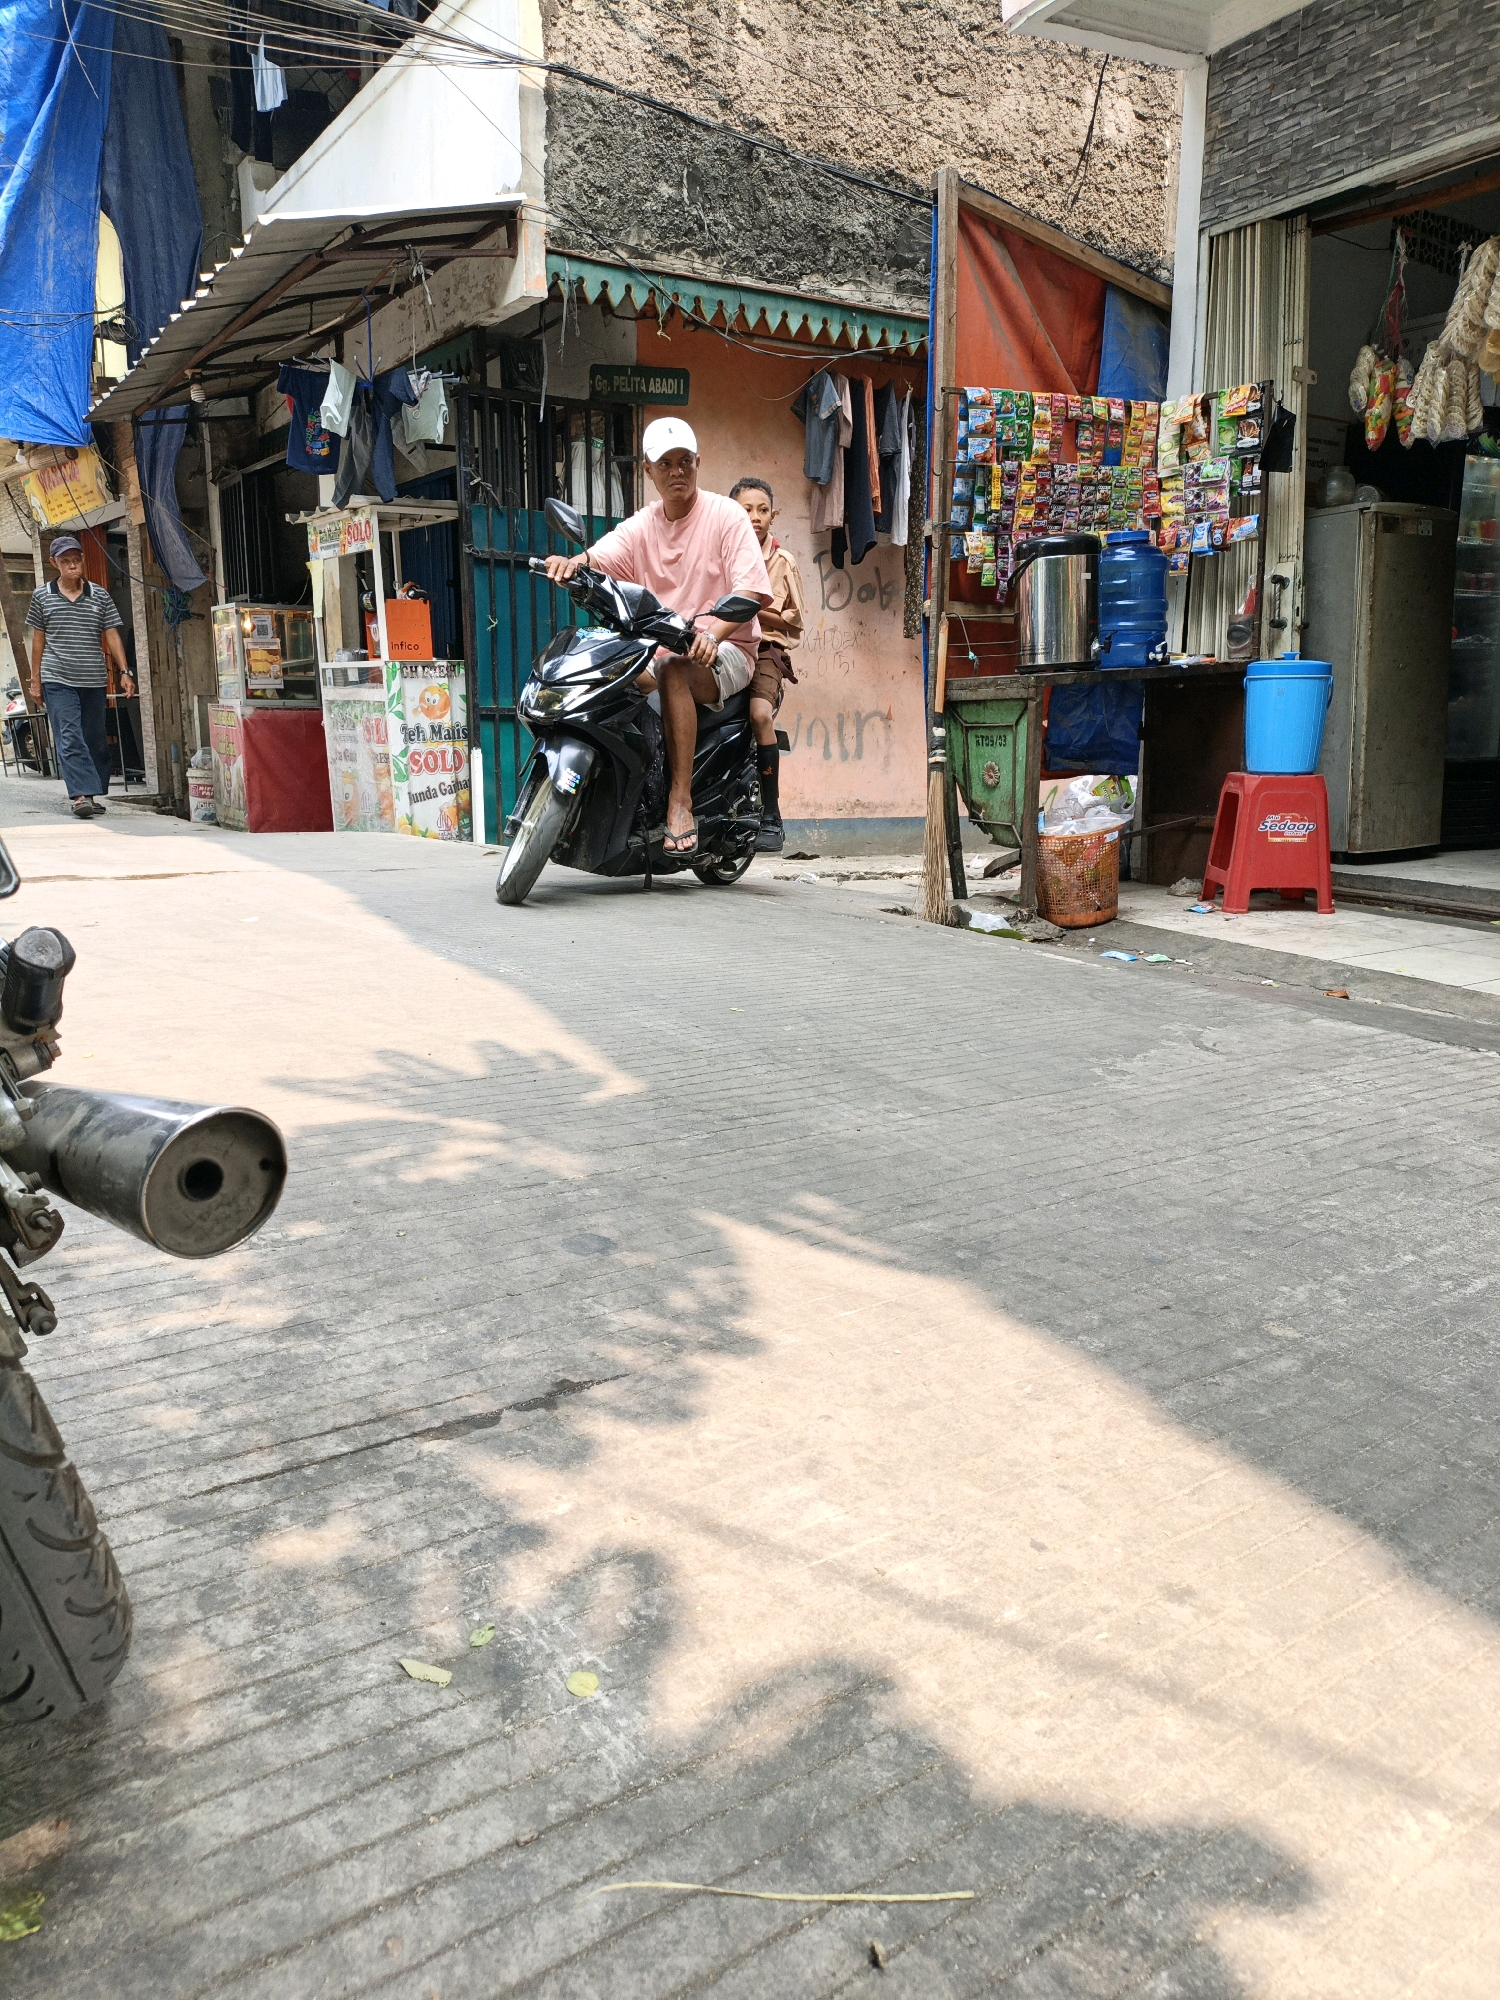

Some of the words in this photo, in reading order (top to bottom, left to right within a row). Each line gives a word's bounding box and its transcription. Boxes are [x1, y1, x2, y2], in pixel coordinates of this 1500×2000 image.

[595, 375, 611, 395] Gg.
[613, 375, 647, 393] PELITA
[648, 377, 678, 394] ABADI
[680, 378, 684, 395] I
[346, 518, 372, 547] SOLO
[391, 641, 419, 651] infico
[401, 723, 426, 744] Teh
[408, 747, 465, 775] SOLO
[1258, 820, 1316, 833] Sedaap
